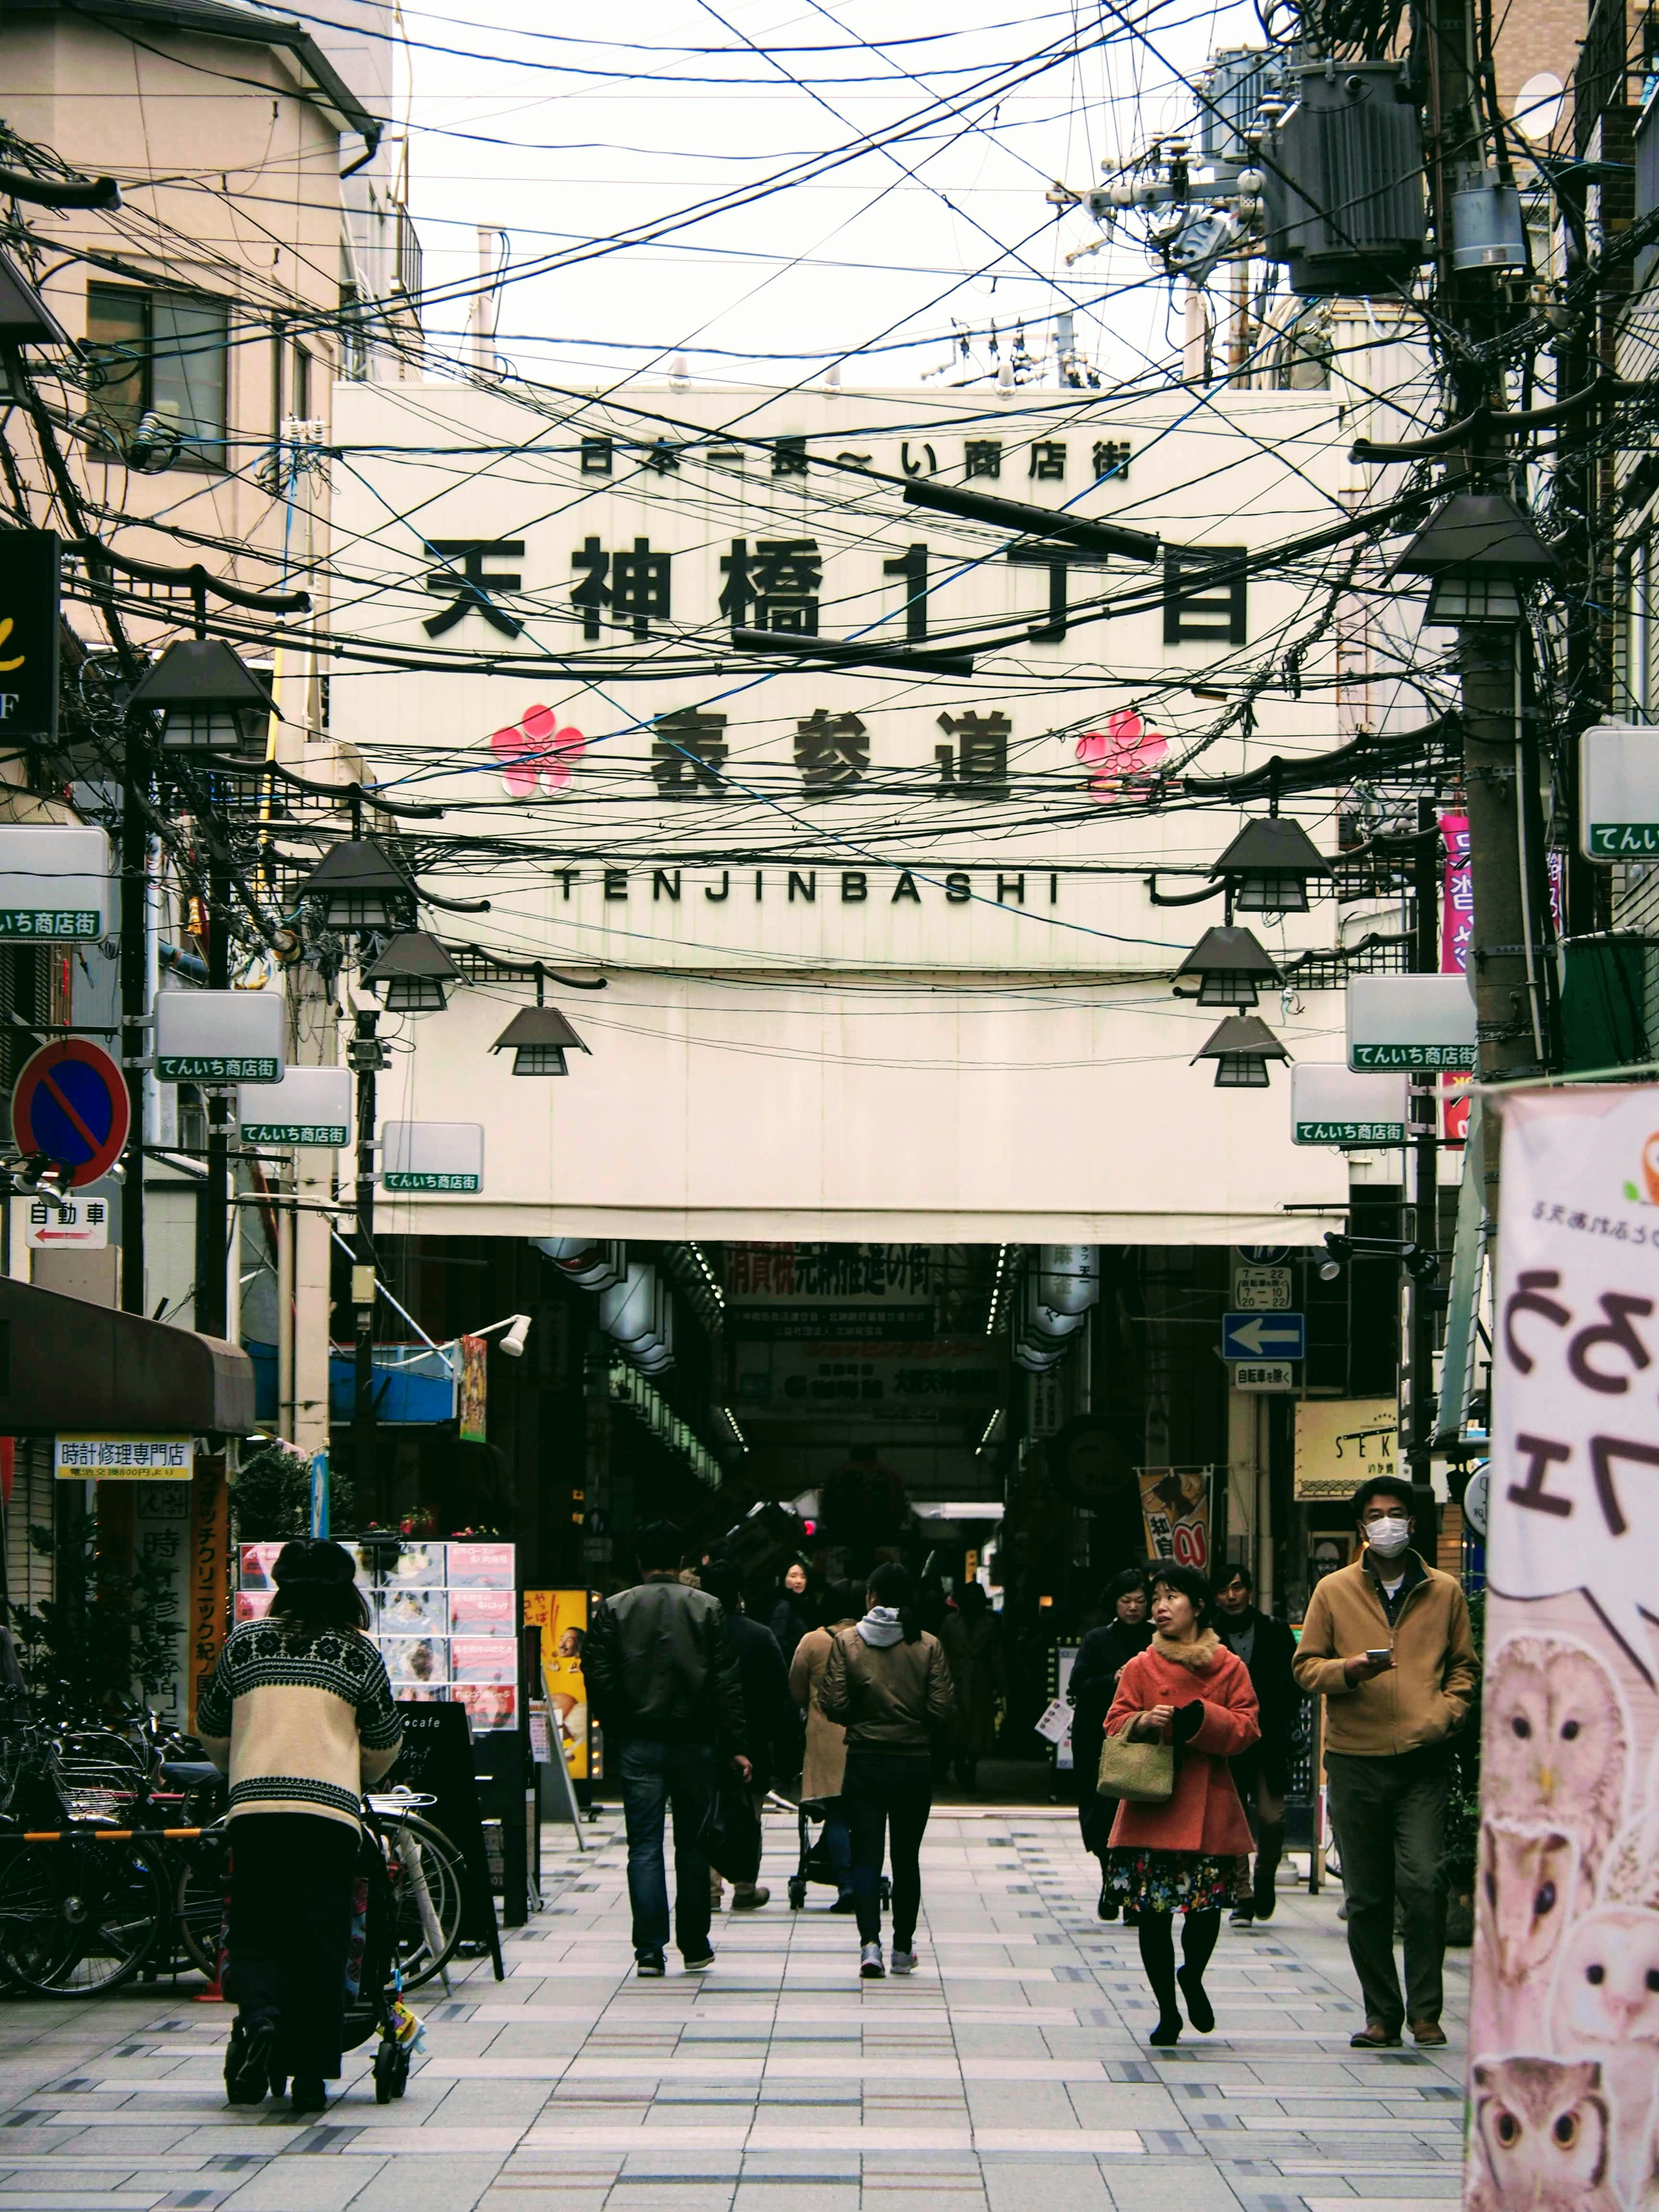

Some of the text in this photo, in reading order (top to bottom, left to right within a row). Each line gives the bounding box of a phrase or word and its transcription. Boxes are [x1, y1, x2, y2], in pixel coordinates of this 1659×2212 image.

[422, 537, 1248, 644] 天神橋1丁目
[651, 709, 1012, 801] 表参道
[553, 869, 1058, 904] TENJINBASHI
[1357, 1046, 1475, 1065] てんいち商店街
[161, 1058, 274, 1077] てんいち商店街
[244, 1126, 343, 1143] てんいち商店街
[1300, 1124, 1401, 1140] てんいち商店街
[387, 1174, 476, 1190] てんいち商店街
[31, 1202, 104, 1226] 自動車
[1238, 1368, 1290, 1383] 自転車を除く
[61, 1443, 185, 1466] 時計修理専門店
[70, 1468, 174, 1477] 電池交換800円より
[412, 1717, 440, 1728] cafe
